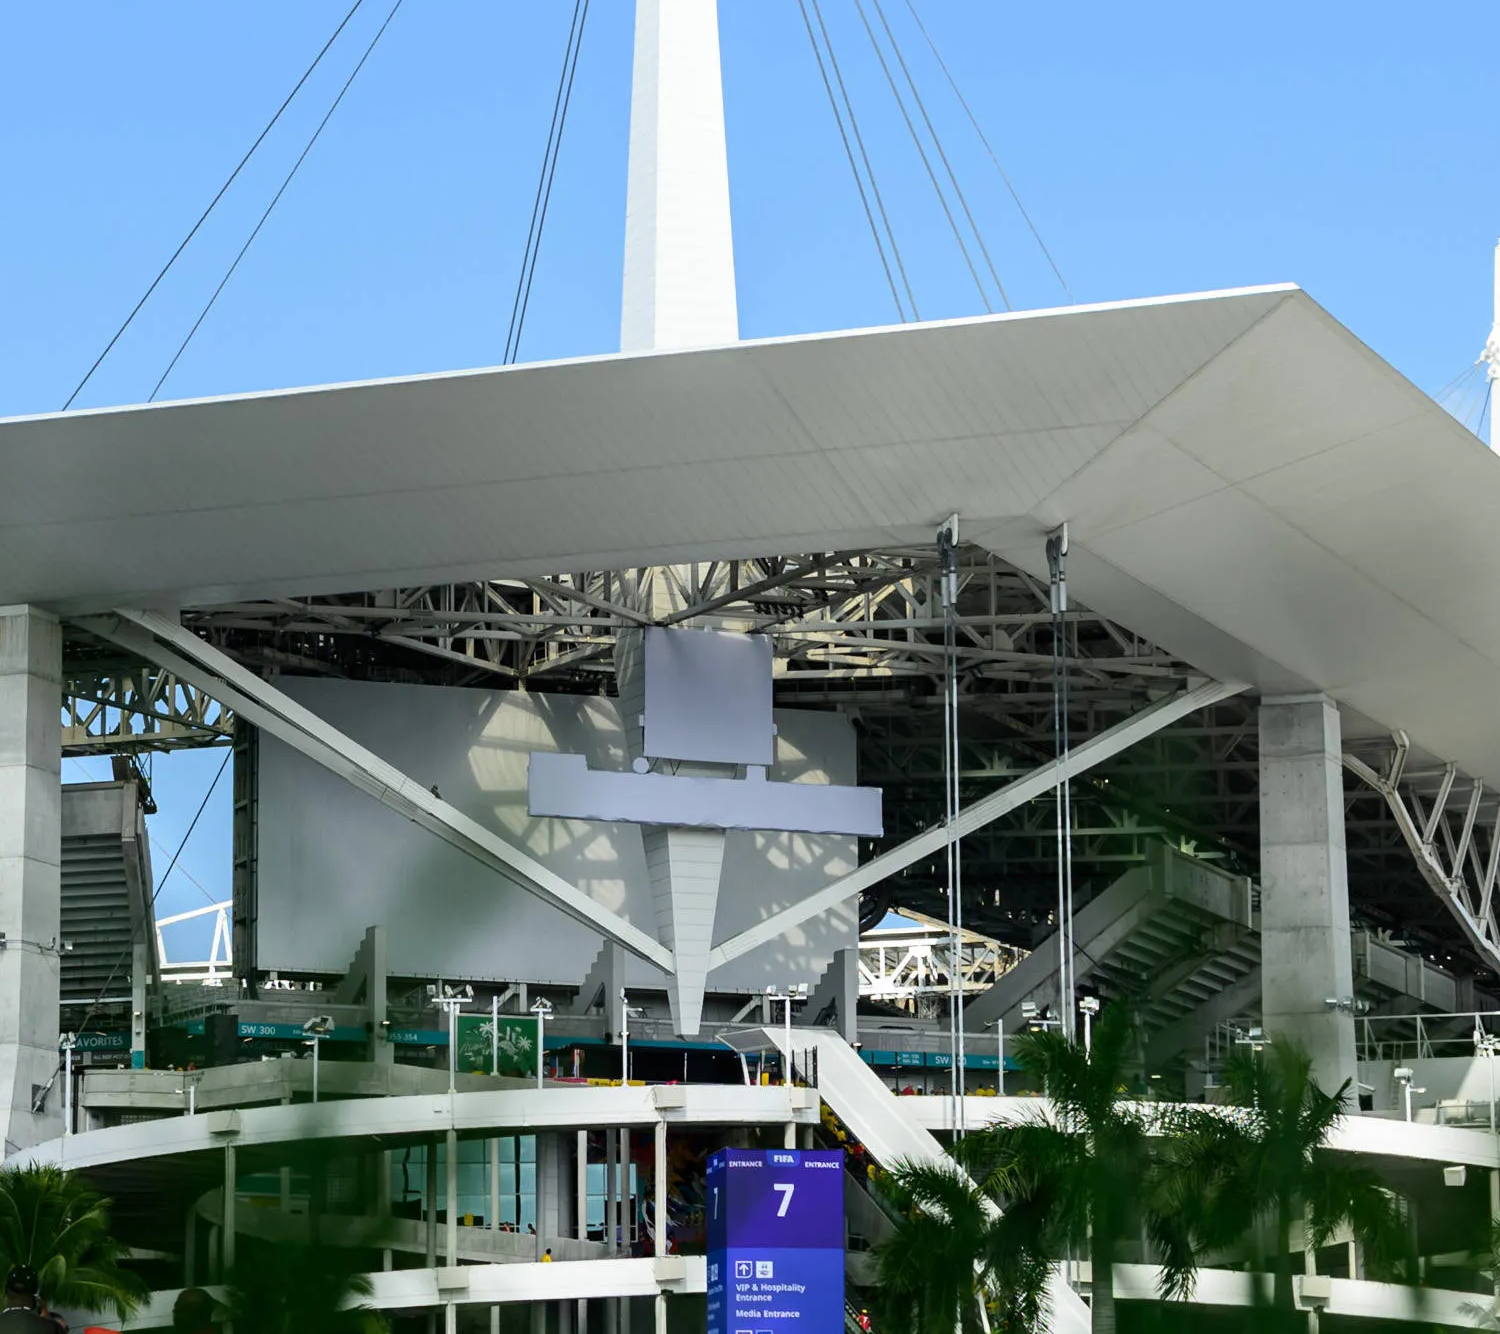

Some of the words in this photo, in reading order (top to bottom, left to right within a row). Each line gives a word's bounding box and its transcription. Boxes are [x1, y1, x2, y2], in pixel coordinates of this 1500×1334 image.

[241, 1025, 256, 1034] SW
[259, 1026, 276, 1035] 300
[76, 1036, 124, 1047] AVORITES
[935, 1056, 949, 1065] SW
[773, 1155, 795, 1163] FIFA
[729, 1160, 763, 1168] ENTRANCE
[804, 1161, 840, 1169] ENTRANCE
[773, 1183, 795, 1217] 7
[760, 1284, 806, 1293] Hospitality
[736, 1310, 761, 1318] Media
[763, 1310, 800, 1318] Entrance
